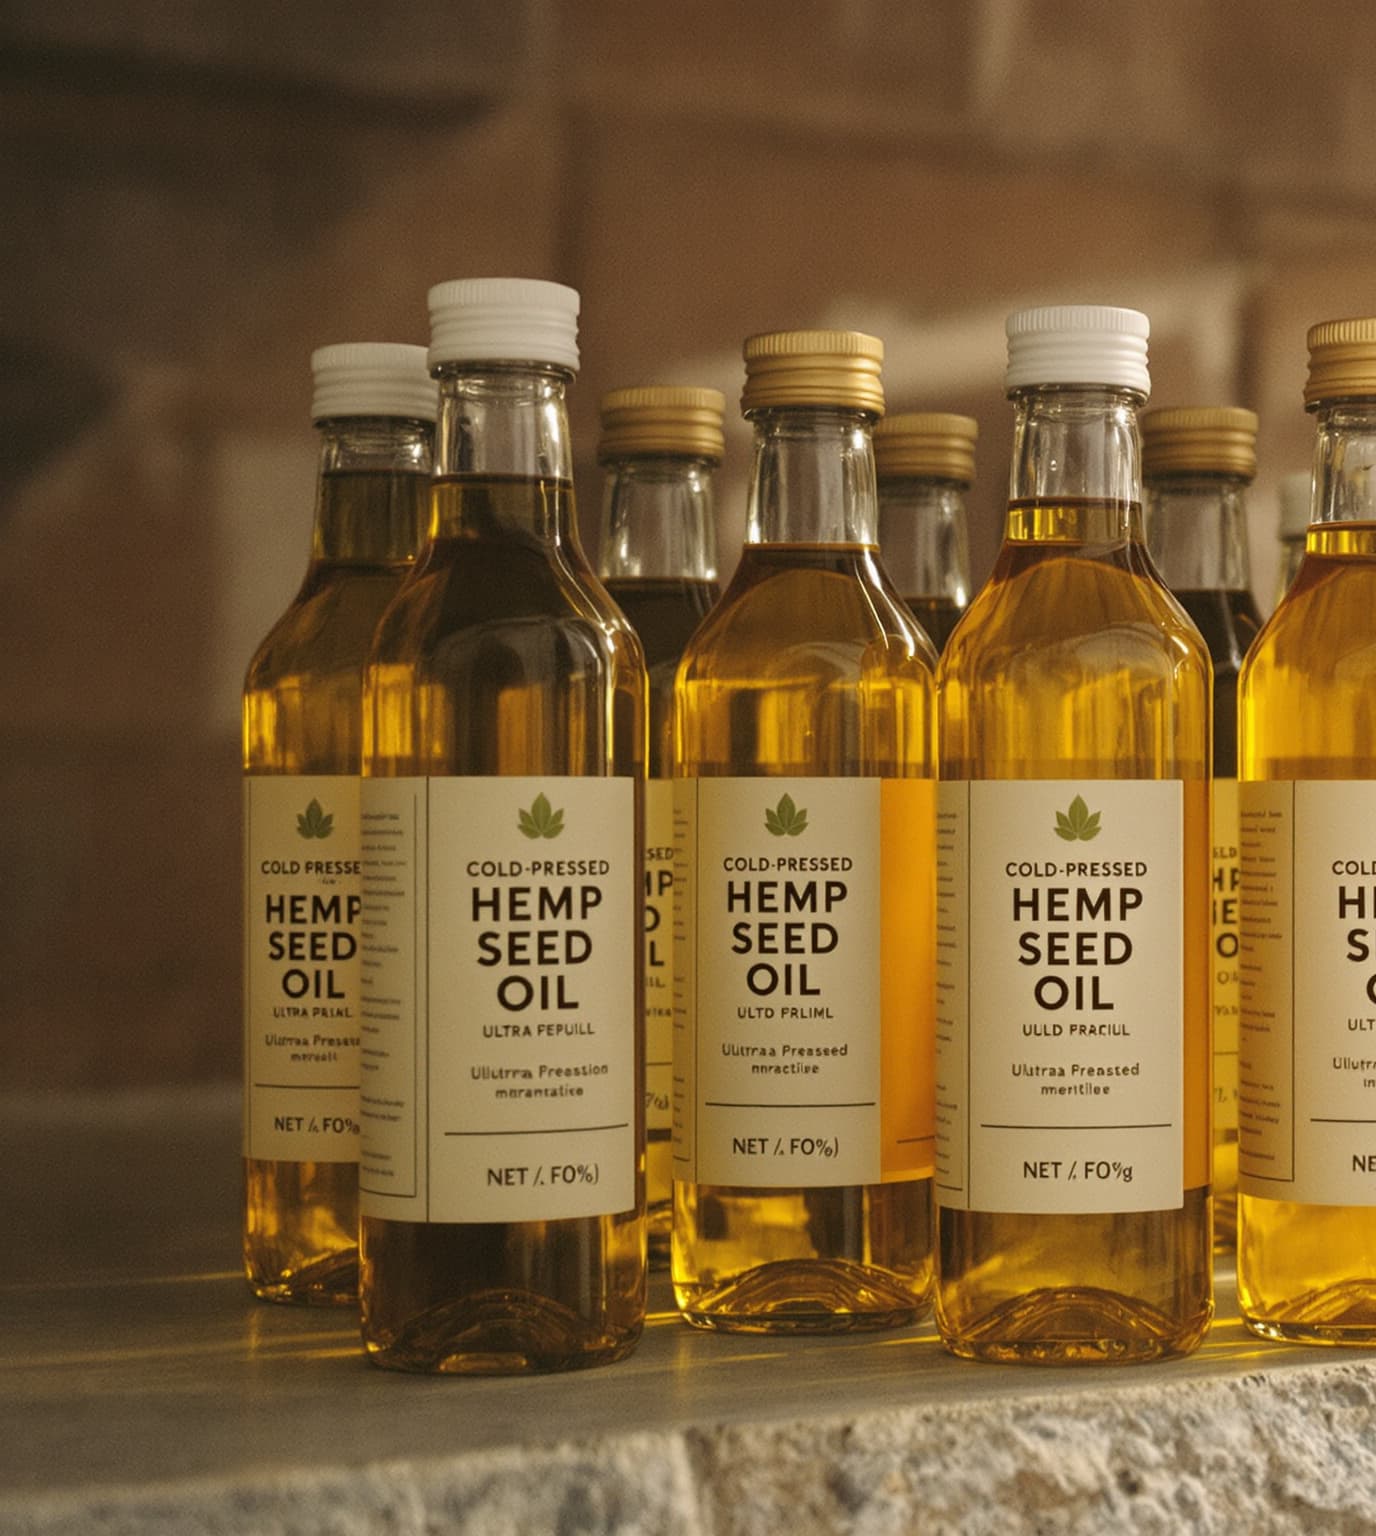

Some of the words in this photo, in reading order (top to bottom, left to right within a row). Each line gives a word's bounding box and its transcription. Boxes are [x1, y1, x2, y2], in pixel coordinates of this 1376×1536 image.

[262, 861, 300, 874] COLD
[305, 861, 360, 874] PRESSE
[466, 859, 610, 877] COLD-PRESSED
[723, 857, 853, 873] COLD-PRESSED
[1005, 861, 1148, 877] COLD-PRESSED
[266, 895, 361, 924] HEMP
[472, 886, 603, 922] HEMP
[727, 880, 848, 913] HEMP
[1012, 888, 1143, 922] HEMP
[269, 931, 357, 961] SEED
[477, 930, 593, 967] SEED
[732, 922, 839, 955] SEED
[1018, 931, 1133, 966] SEED
[282, 969, 345, 999] OIL
[497, 975, 580, 1012] OIL
[746, 963, 821, 997] OIL
[1034, 975, 1114, 1011] OIL
[483, 1025, 532, 1038] ULTRA
[274, 1117, 303, 1132] NET
[733, 1138, 769, 1155] NET
[487, 1168, 529, 1186] NET
[1023, 1161, 1062, 1179] NET
